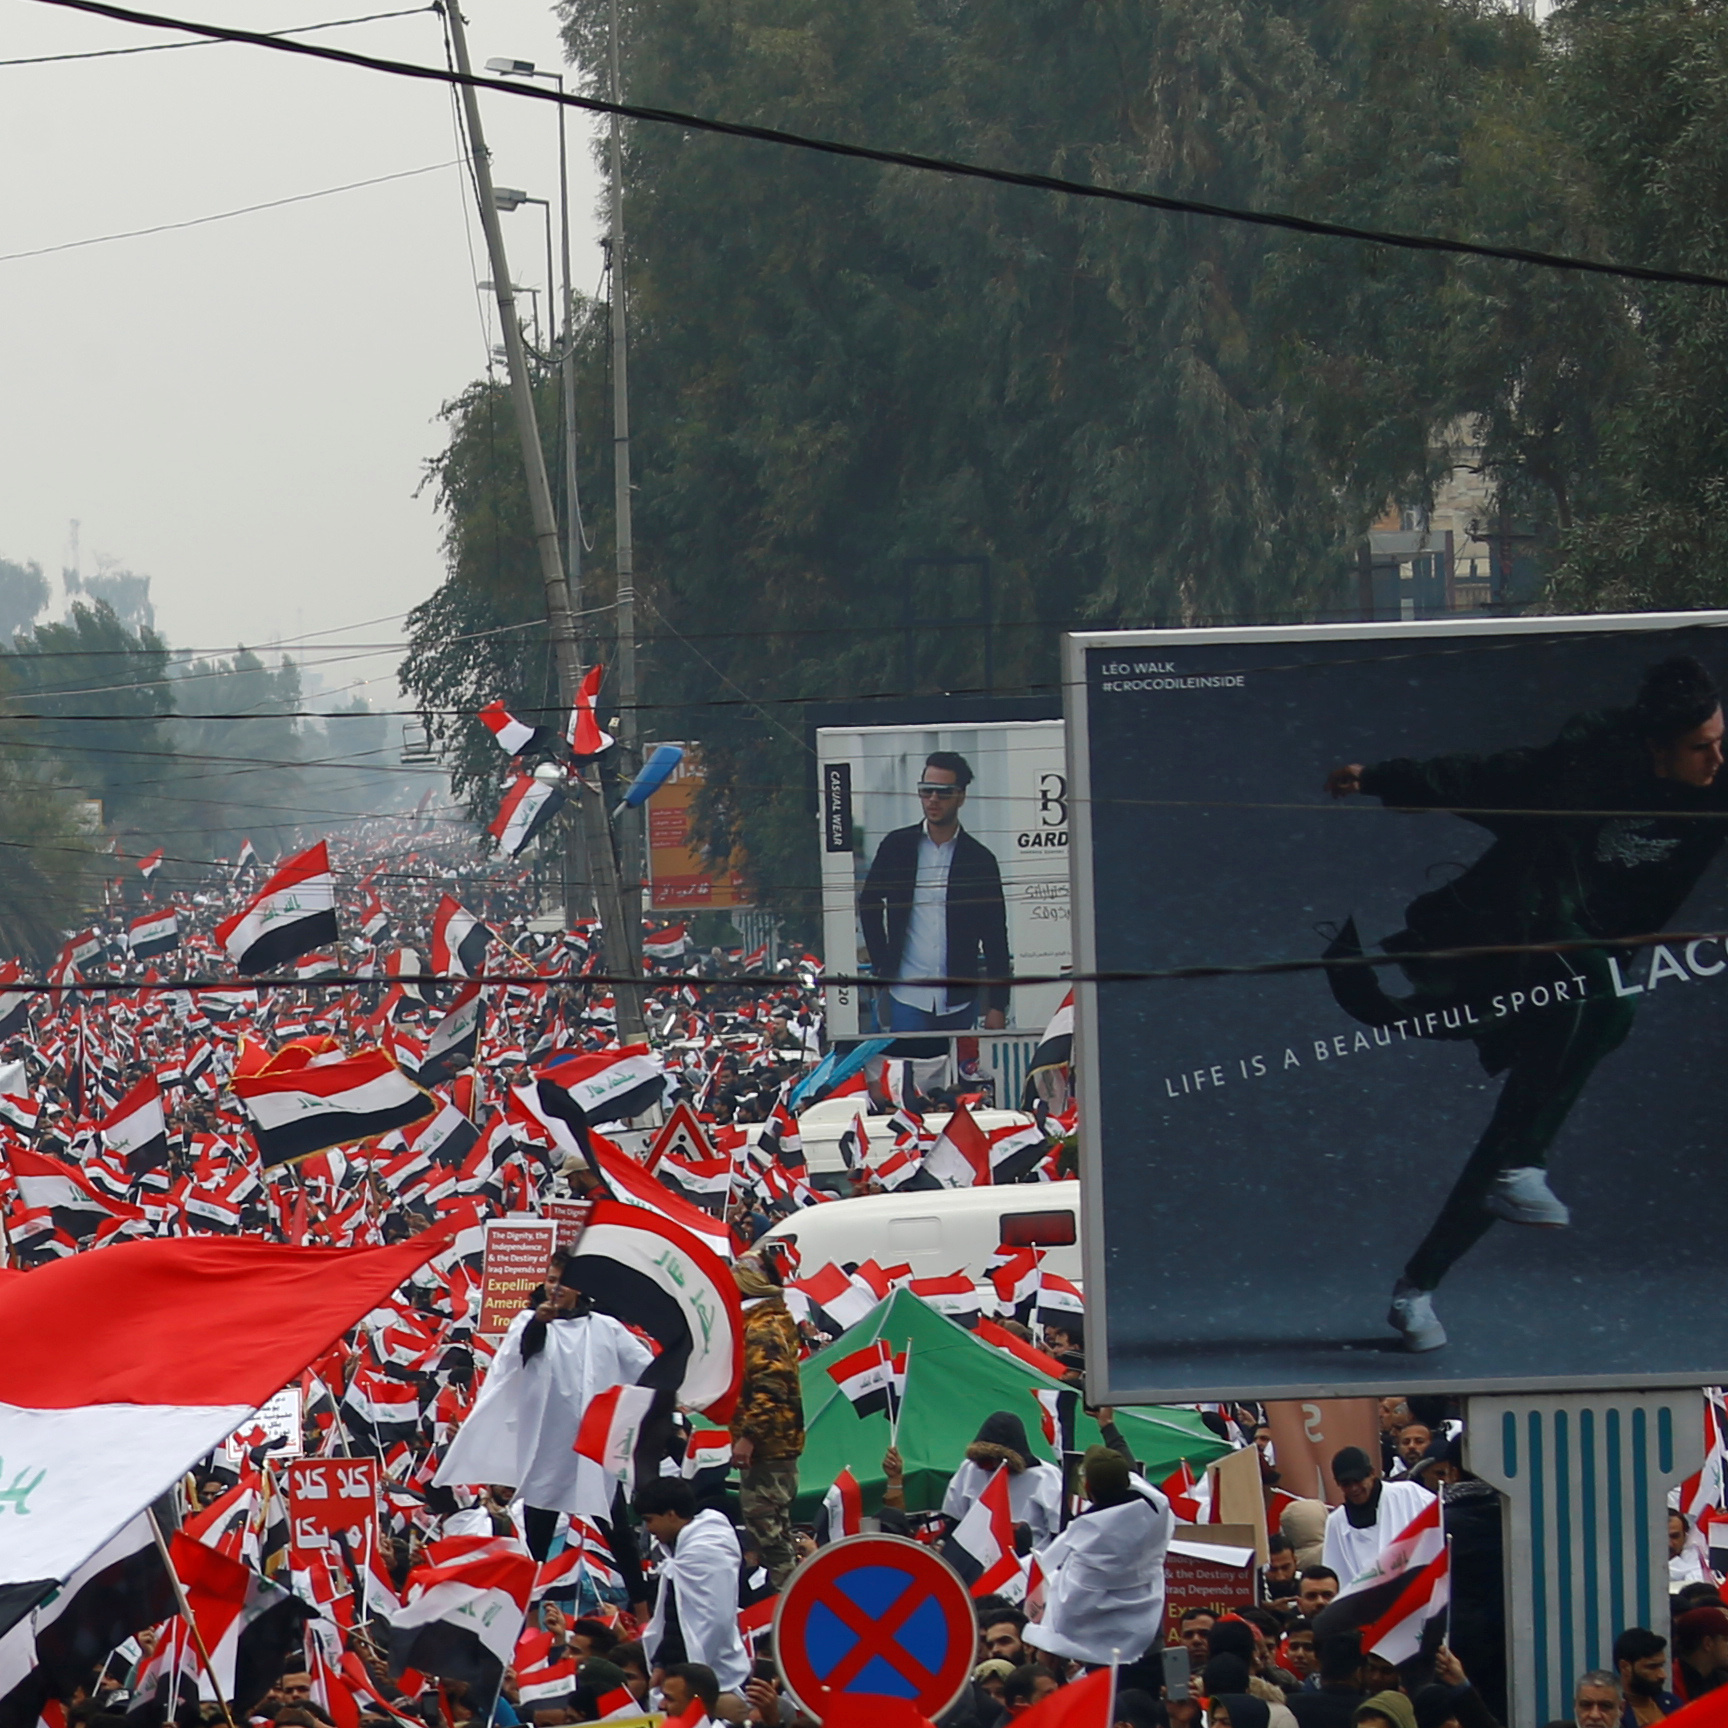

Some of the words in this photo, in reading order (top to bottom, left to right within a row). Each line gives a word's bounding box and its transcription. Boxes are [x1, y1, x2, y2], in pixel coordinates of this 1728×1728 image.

[1133, 662, 1175, 674] WALK
[1102, 676, 1245, 692] #CROCODILEINSIDE
[830, 770, 841, 812] CASUAL
[832, 813, 842, 846] WEAR
[1018, 832, 1069, 848] GARD
[1164, 1066, 1225, 1097] LIFE
[1240, 1056, 1266, 1080] IS
[1283, 1048, 1300, 1070] A
[1314, 1003, 1479, 1061] BEAUTIFUL
[1493, 974, 1588, 1017] SPORT
[1607, 937, 1728, 998] LAC
[492, 1231, 505, 1239] The
[535, 1231, 549, 1239] the
[497, 1254, 509, 1262] the
[510, 1254, 537, 1263] Destiny
[539, 1254, 548, 1262] of
[488, 1266, 502, 1274] Iraq
[504, 1265, 535, 1274] Depends
[485, 1297, 530, 1309] Americ
[492, 1315, 510, 1327] Tro
[294, 1466, 328, 1500] كلا
[336, 1465, 371, 1499] كلا
[295, 1515, 373, 1550] اميكا
[1176, 1569, 1194, 1579] the
[1196, 1569, 1235, 1583] Destiny
[1238, 1569, 1249, 1580] of
[1188, 1585, 1234, 1597] Depends
[1236, 1586, 1250, 1595] on
